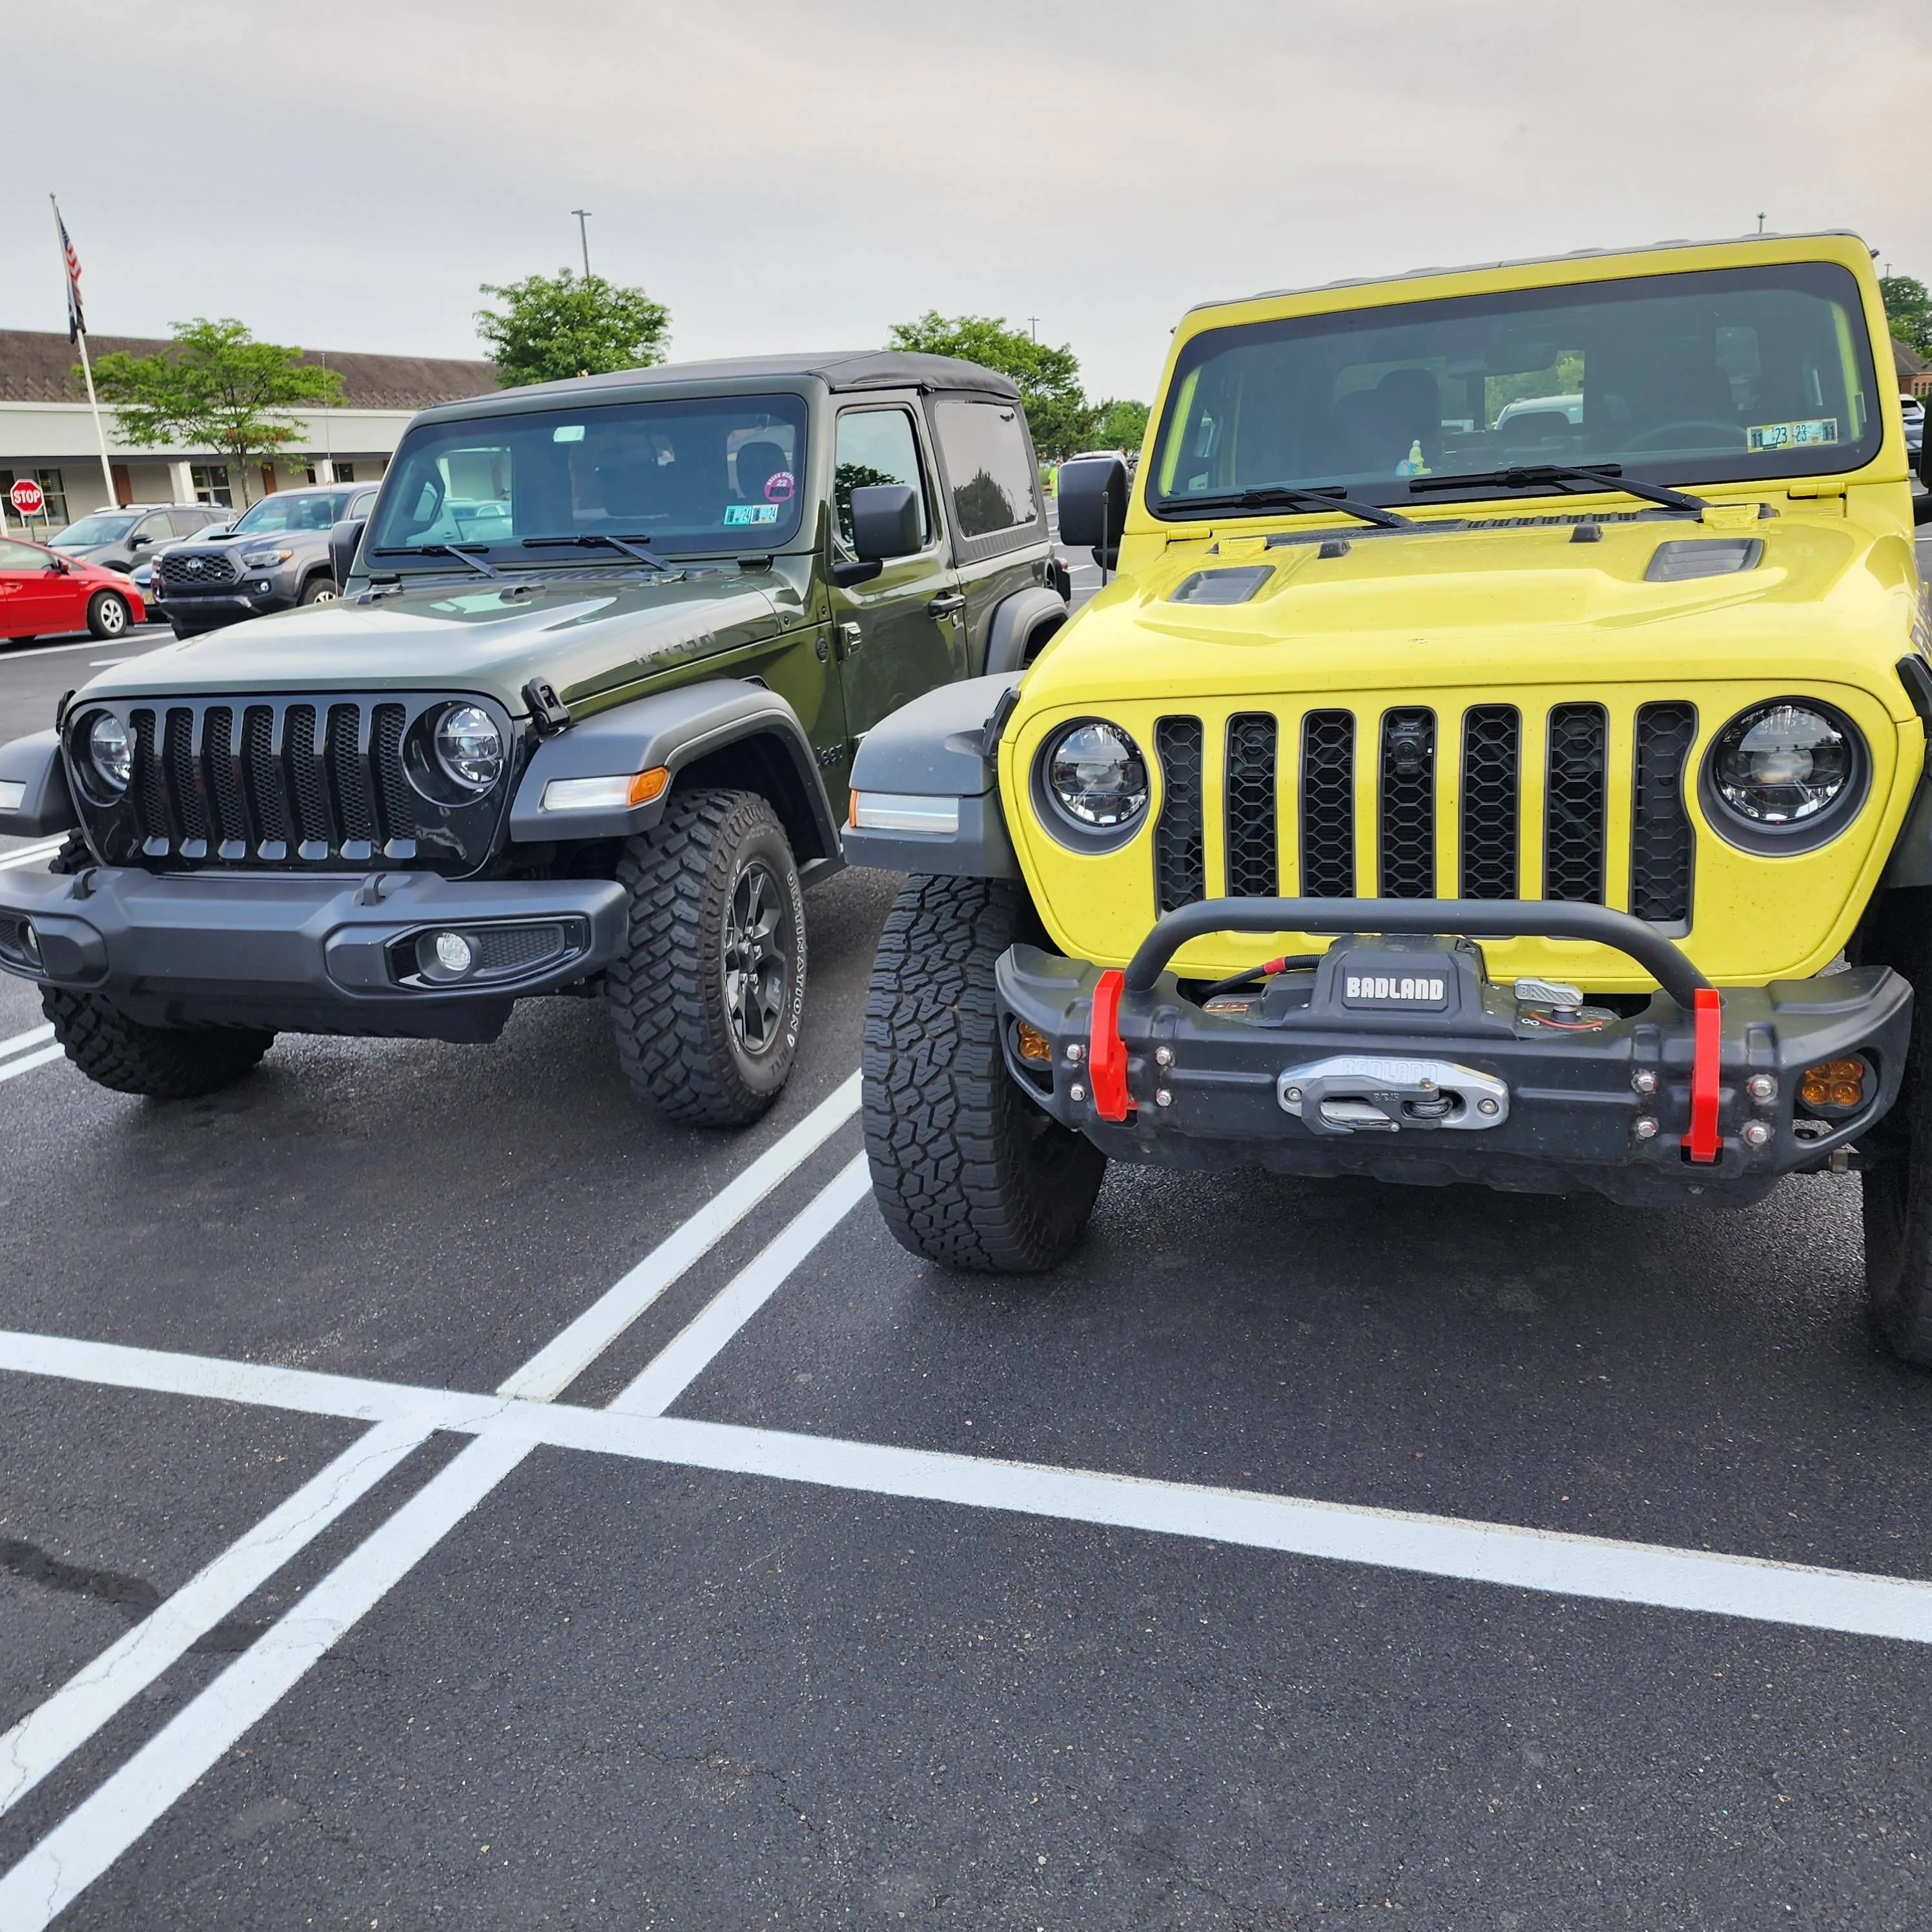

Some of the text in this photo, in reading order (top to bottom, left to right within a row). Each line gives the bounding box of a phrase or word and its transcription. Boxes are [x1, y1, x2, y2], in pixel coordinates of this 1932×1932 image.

[1751, 426, 1788, 448] 11 23
[1796, 424, 1835, 442] 23 11
[13, 489, 41, 504] STOP
[816, 743, 843, 767] Jeep
[786, 869, 805, 1033] DESTINATION
[1346, 976, 1444, 1001] BADLAND
[1341, 1059, 1438, 1083] BADLAND
